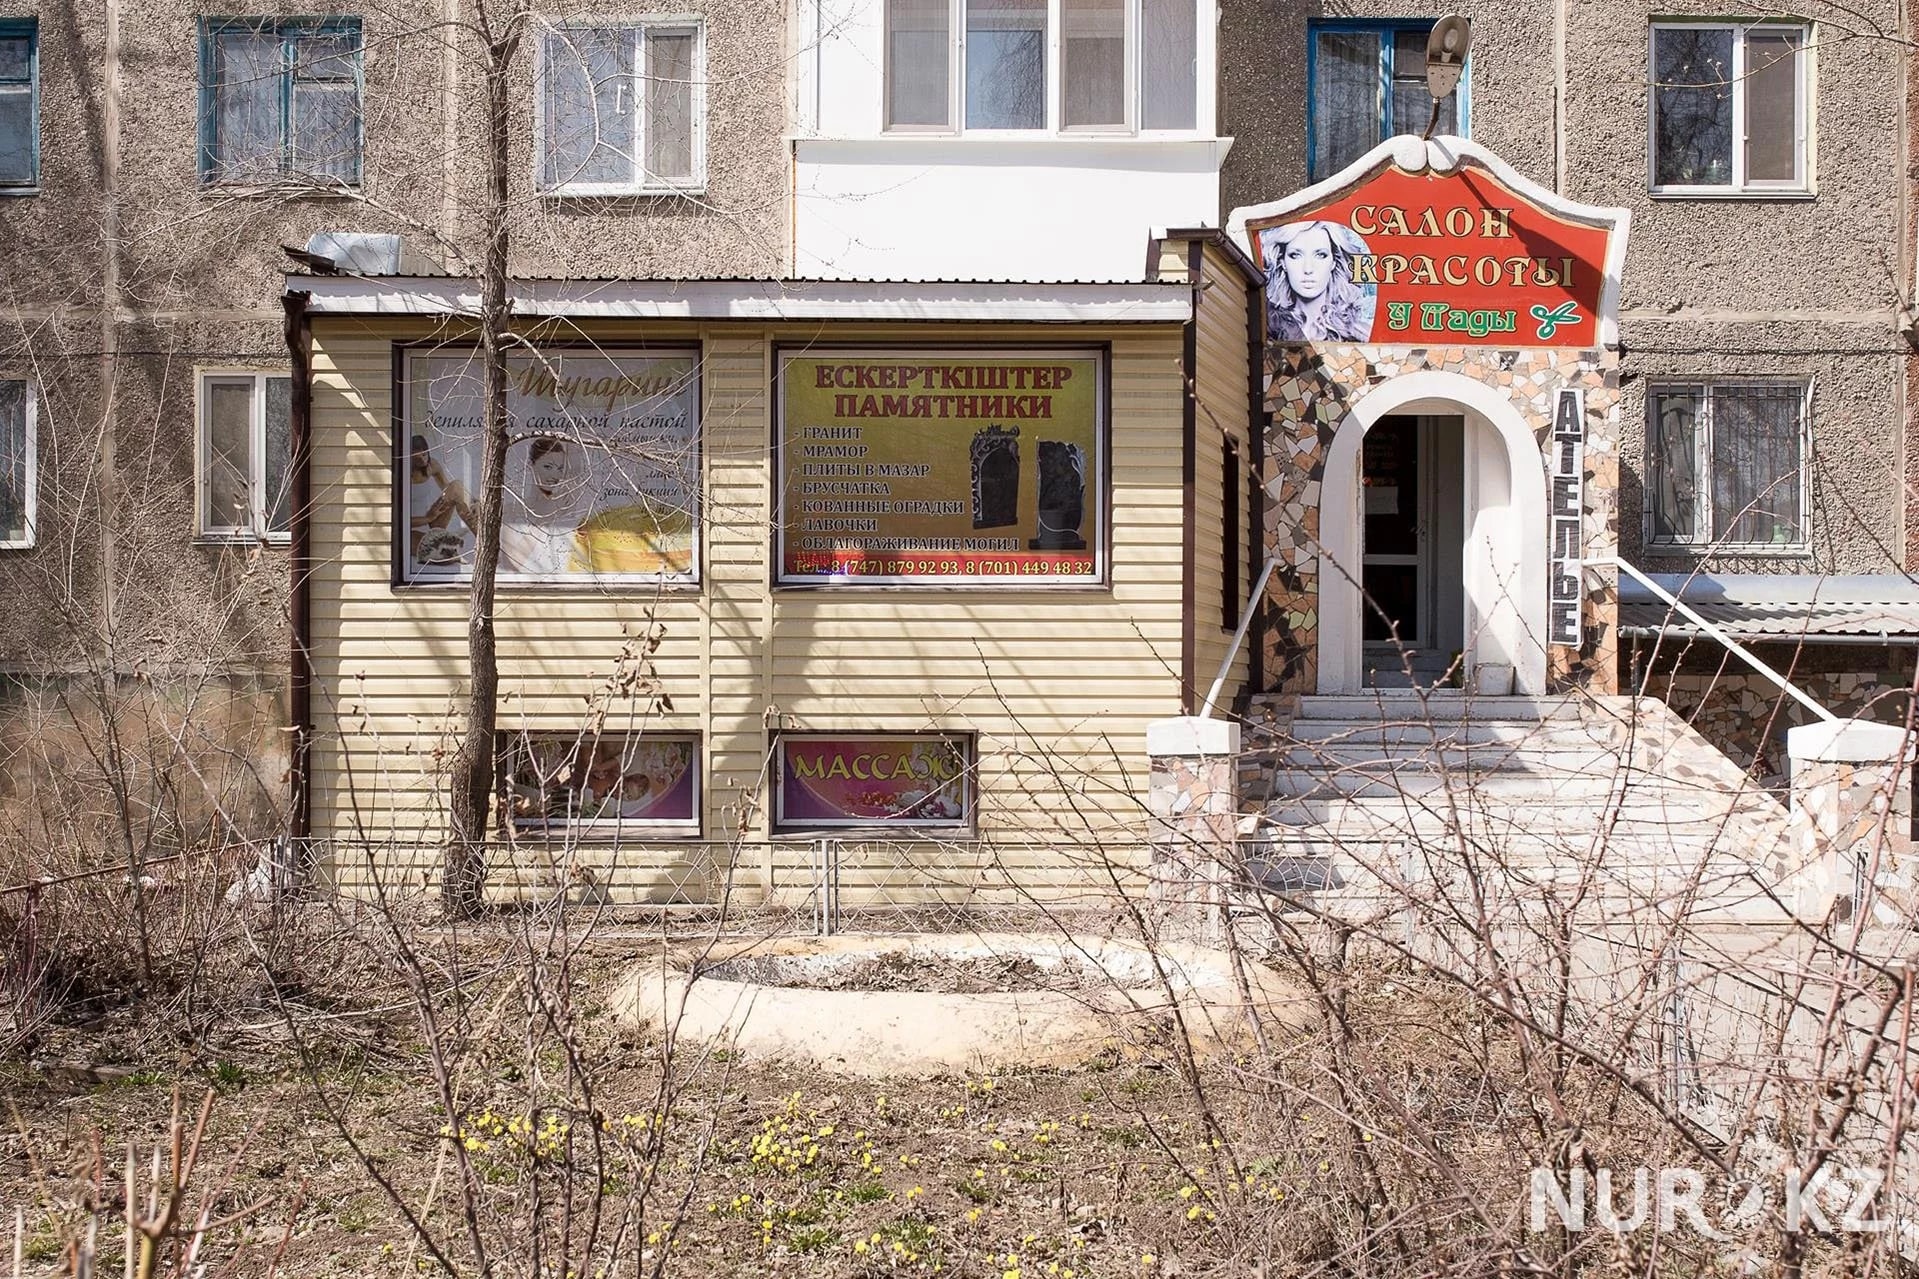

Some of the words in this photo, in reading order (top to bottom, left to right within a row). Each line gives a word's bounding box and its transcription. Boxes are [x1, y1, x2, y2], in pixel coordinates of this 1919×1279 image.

[1350, 204, 1513, 239] САЛОН
[1349, 254, 1577, 288] КРАСОТЫ
[1387, 302, 1414, 331] У
[1419, 302, 1517, 338] Лады
[814, 365, 1073, 390] ЕСКЕРТКІШТЕР
[834, 394, 1053, 419] ПАМЯТНИКИ
[803, 426, 863, 440] ГРАНИТ
[803, 445, 868, 458] МРАМОР
[802, 463, 861, 477] ПЛИТЫ
[865, 464, 875, 477] В
[878, 464, 930, 478] МАЗАР
[802, 481, 891, 496] БРУСЧАТКА
[802, 500, 890, 514] КОВАННЫЕ
[894, 501, 964, 516] ОГРАДКИ
[1551, 391, 1582, 643] АТЕЛЬЕ
[801, 518, 878, 532] ЛАВОЧКИ
[801, 536, 961, 551] ОБЛАГОРАЖИВАНИЕ
[964, 537, 1020, 552] МОГИЛ
[831, 560, 840, 573] 8
[844, 559, 883, 576] (747)
[887, 561, 914, 574] 879
[918, 561, 936, 574] 92
[940, 561, 963, 577] 93,
[966, 561, 975, 574] 8
[978, 560, 1018, 576] (701)
[1020, 561, 1049, 574] 449
[1052, 561, 1071, 574] 48
[1074, 561, 1092, 574] 32
[794, 752, 957, 781] МАССАЖ
